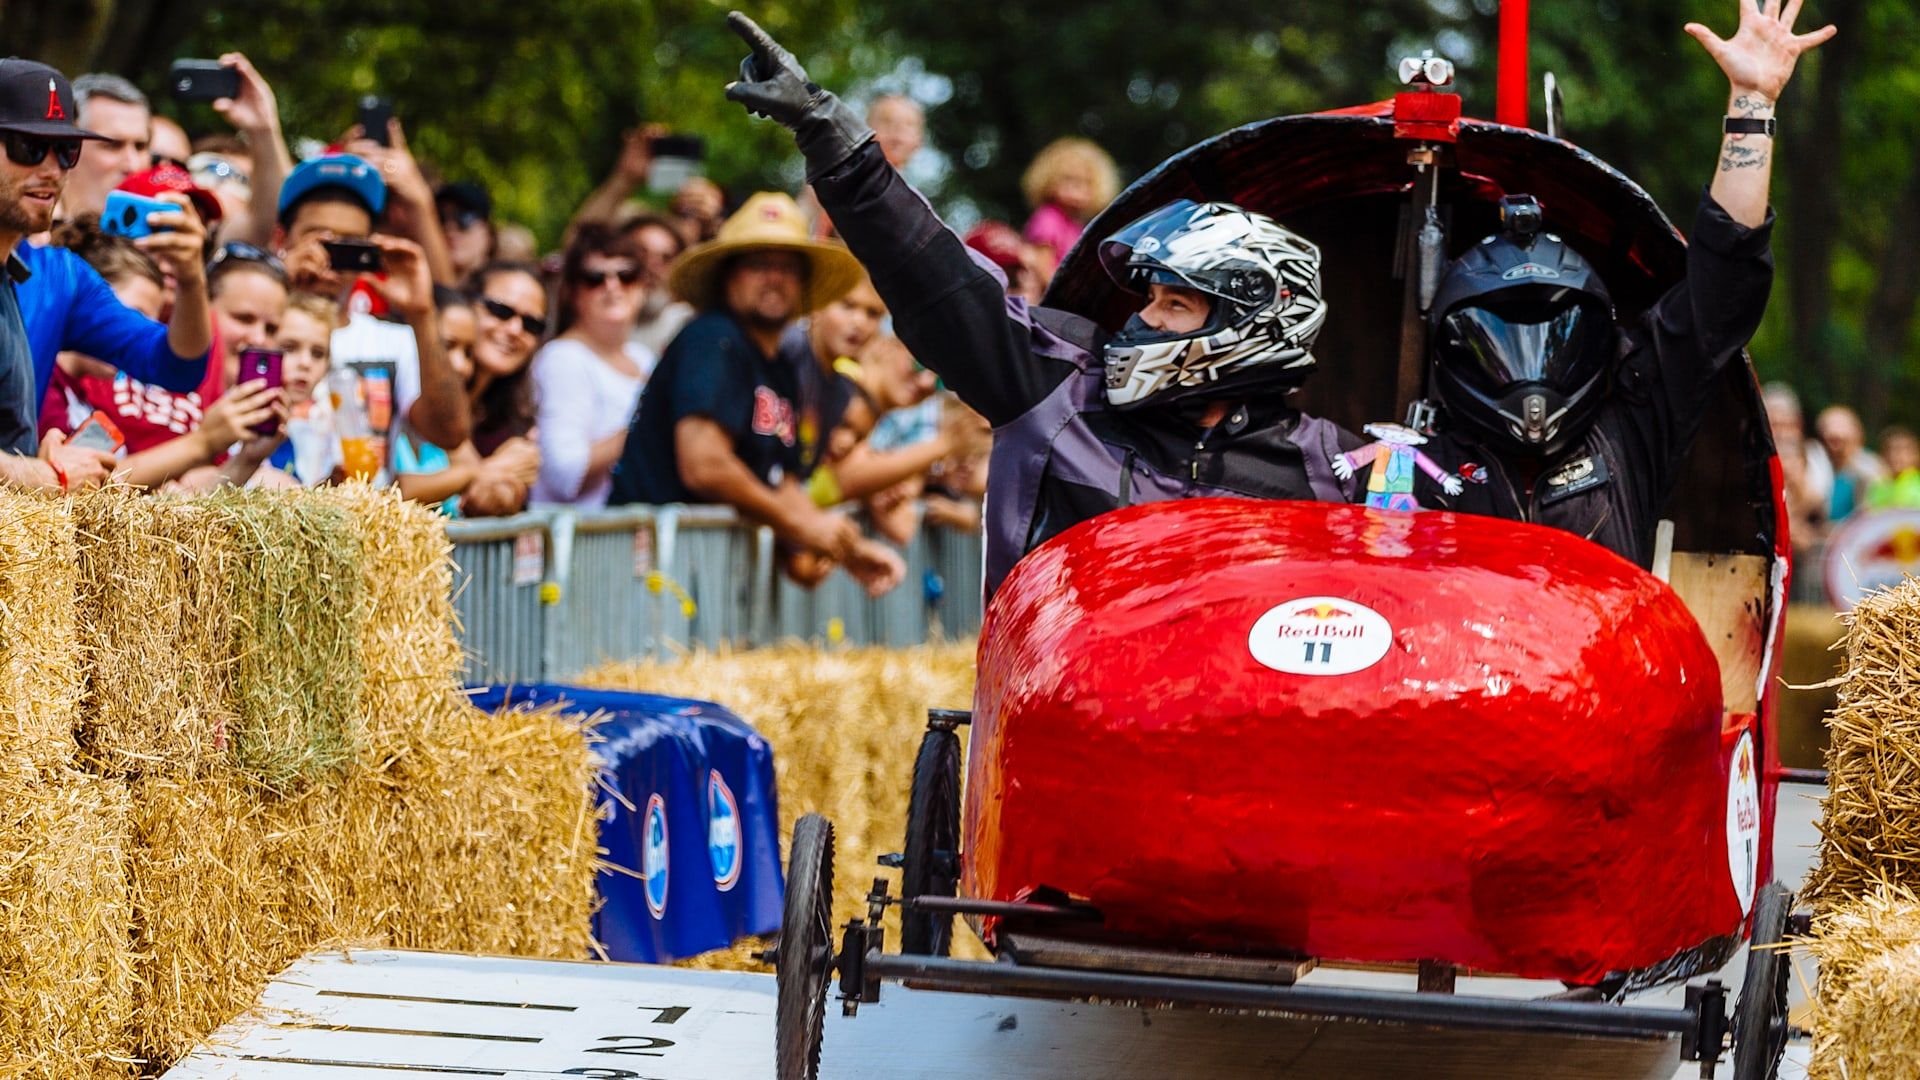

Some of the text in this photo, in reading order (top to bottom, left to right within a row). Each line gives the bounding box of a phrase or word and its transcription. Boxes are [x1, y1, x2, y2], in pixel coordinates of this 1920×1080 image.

[1278, 624, 1364, 639] Red Bull
[1303, 641, 1332, 664] 11
[637, 1005, 692, 1025] 1
[582, 1035, 676, 1057] 2
